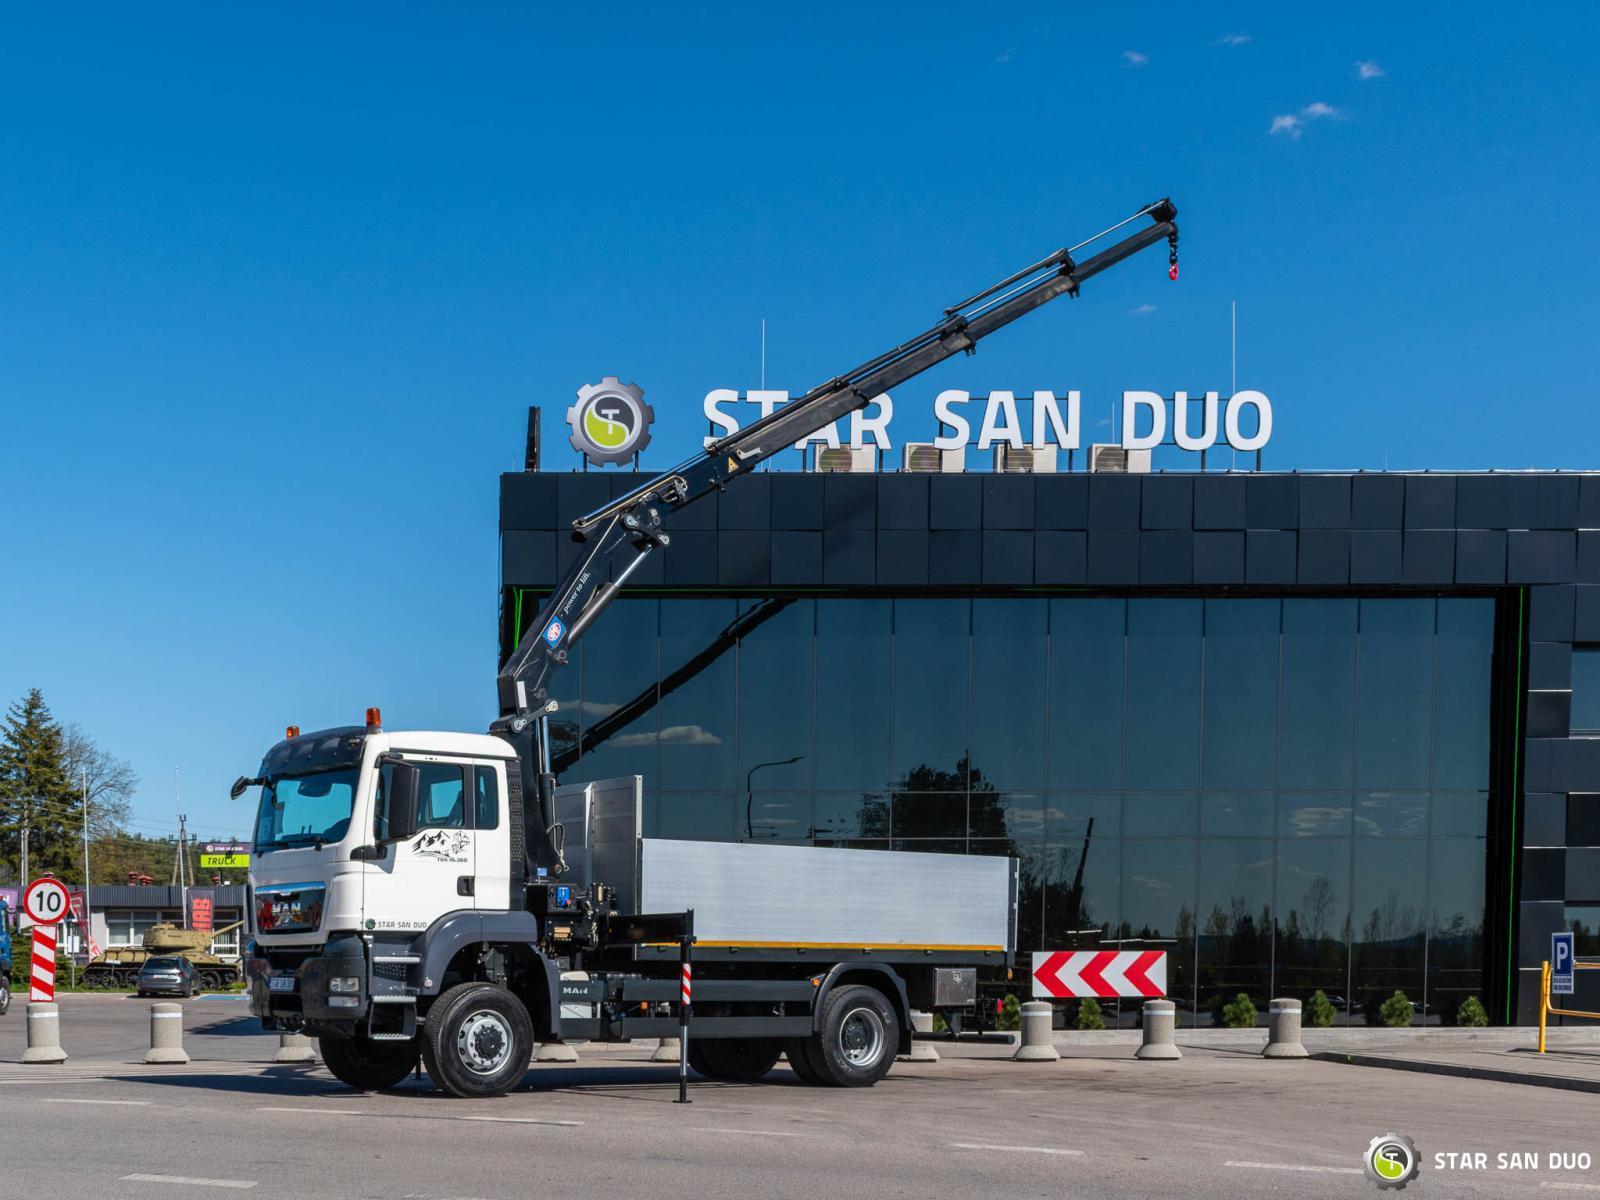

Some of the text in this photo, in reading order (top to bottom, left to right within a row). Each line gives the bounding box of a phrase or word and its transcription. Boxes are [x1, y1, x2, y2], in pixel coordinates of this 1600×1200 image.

[934, 389, 1081, 451] SAN
[1122, 390, 1273, 452] DUO
[563, 592, 578, 614] power
[207, 857, 236, 865] TRUCK
[36, 890, 61, 912] 10
[272, 902, 301, 913] MAN
[378, 921, 427, 929] STAR SAN DUO
[1556, 942, 1569, 970] P
